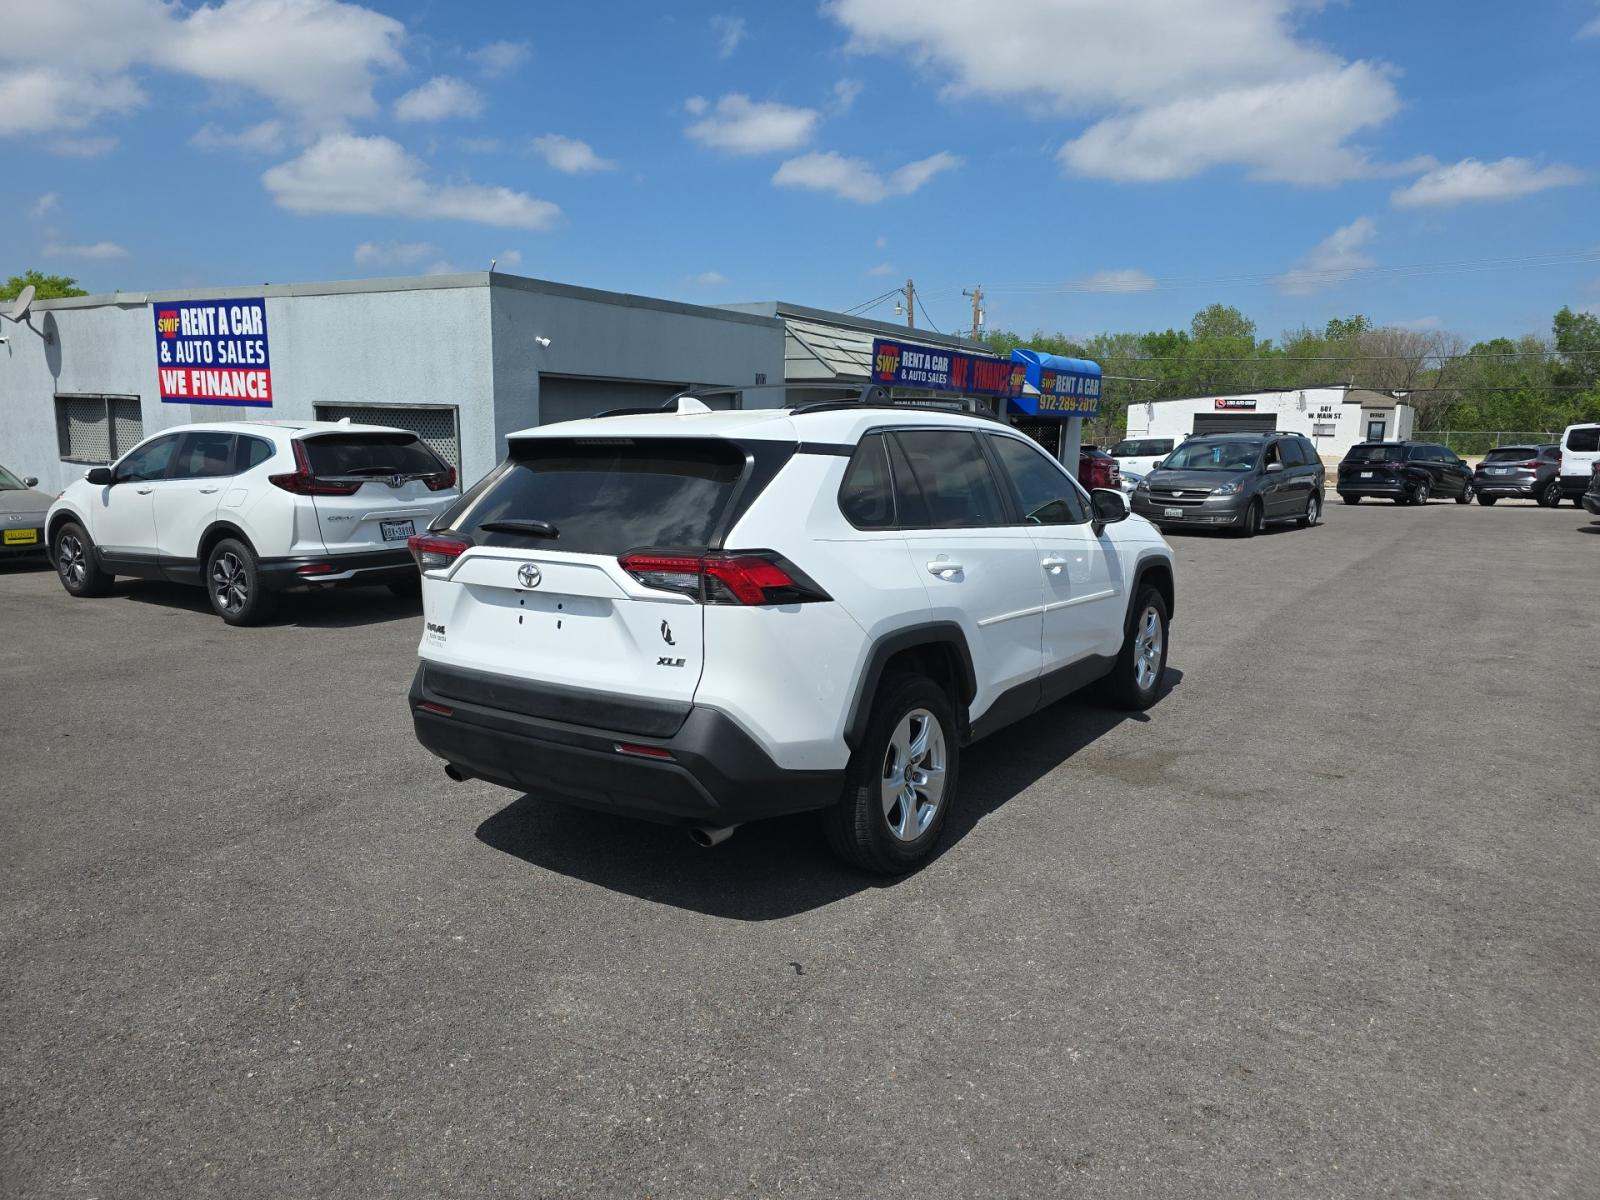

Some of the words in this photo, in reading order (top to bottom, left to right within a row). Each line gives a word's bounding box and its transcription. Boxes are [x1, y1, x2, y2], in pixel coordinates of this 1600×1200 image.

[180, 307, 215, 335] RENT
[218, 307, 229, 335] A
[231, 306, 263, 335] CAR
[161, 341, 171, 363] &
[176, 341, 213, 363] AUTO
[217, 340, 265, 364] SALES
[902, 351, 924, 368] RENT
[924, 354, 931, 369] A
[931, 355, 949, 372] CAR
[161, 370, 188, 395] WE
[191, 370, 268, 398] FINANCE
[901, 369, 907, 379] &
[908, 370, 926, 381] AUTO
[927, 372, 947, 384] SALES
[1056, 375, 1076, 393] RENT
[1077, 378, 1083, 394] A
[1084, 378, 1099, 396] CAR
[656, 657, 686, 667] XLE
